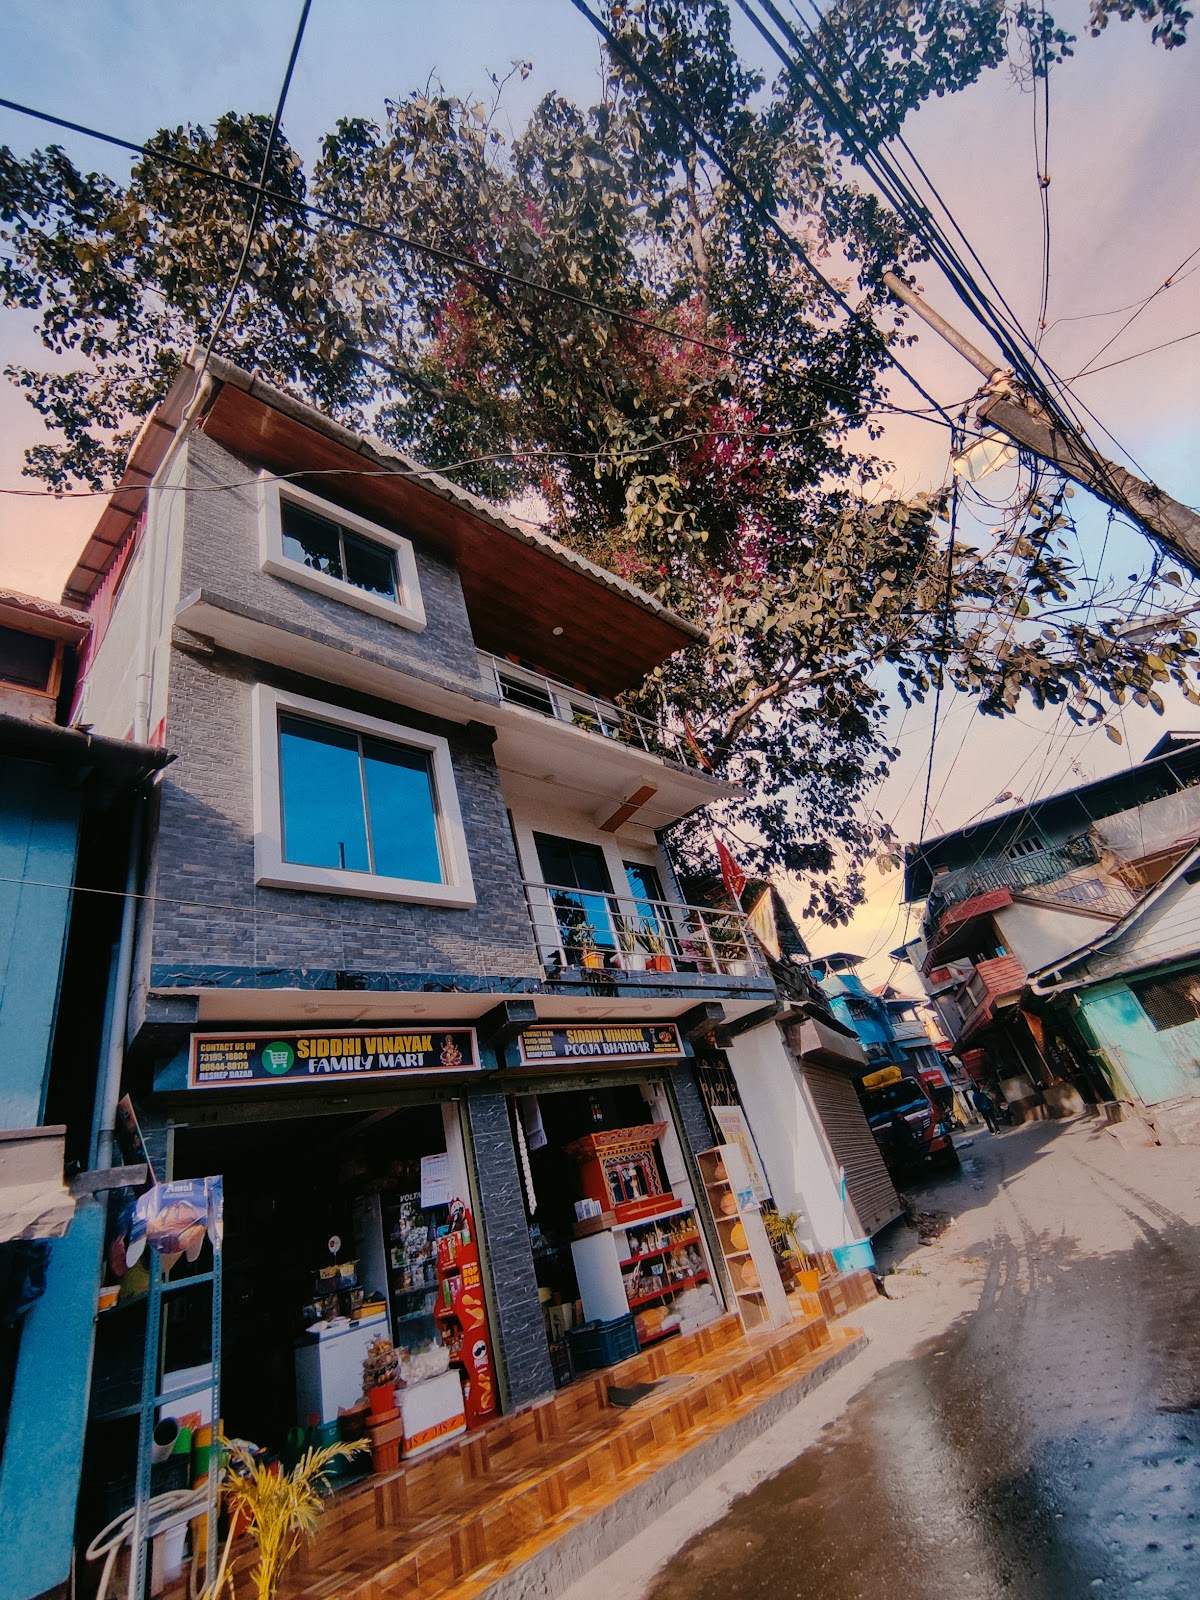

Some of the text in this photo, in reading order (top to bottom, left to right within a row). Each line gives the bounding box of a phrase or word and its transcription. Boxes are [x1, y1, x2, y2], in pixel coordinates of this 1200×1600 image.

[603, 1029, 644, 1042] VINAYAK
[200, 1043, 234, 1051] CONTACT
[246, 1042, 256, 1050] ON
[297, 1035, 433, 1058] SIDDHI VINAYAK
[564, 1043, 601, 1055] POOJA
[602, 1042, 650, 1054] BHANDAR
[308, 1052, 425, 1073] FAMILY MART
[165, 1183, 193, 1193] Amul
